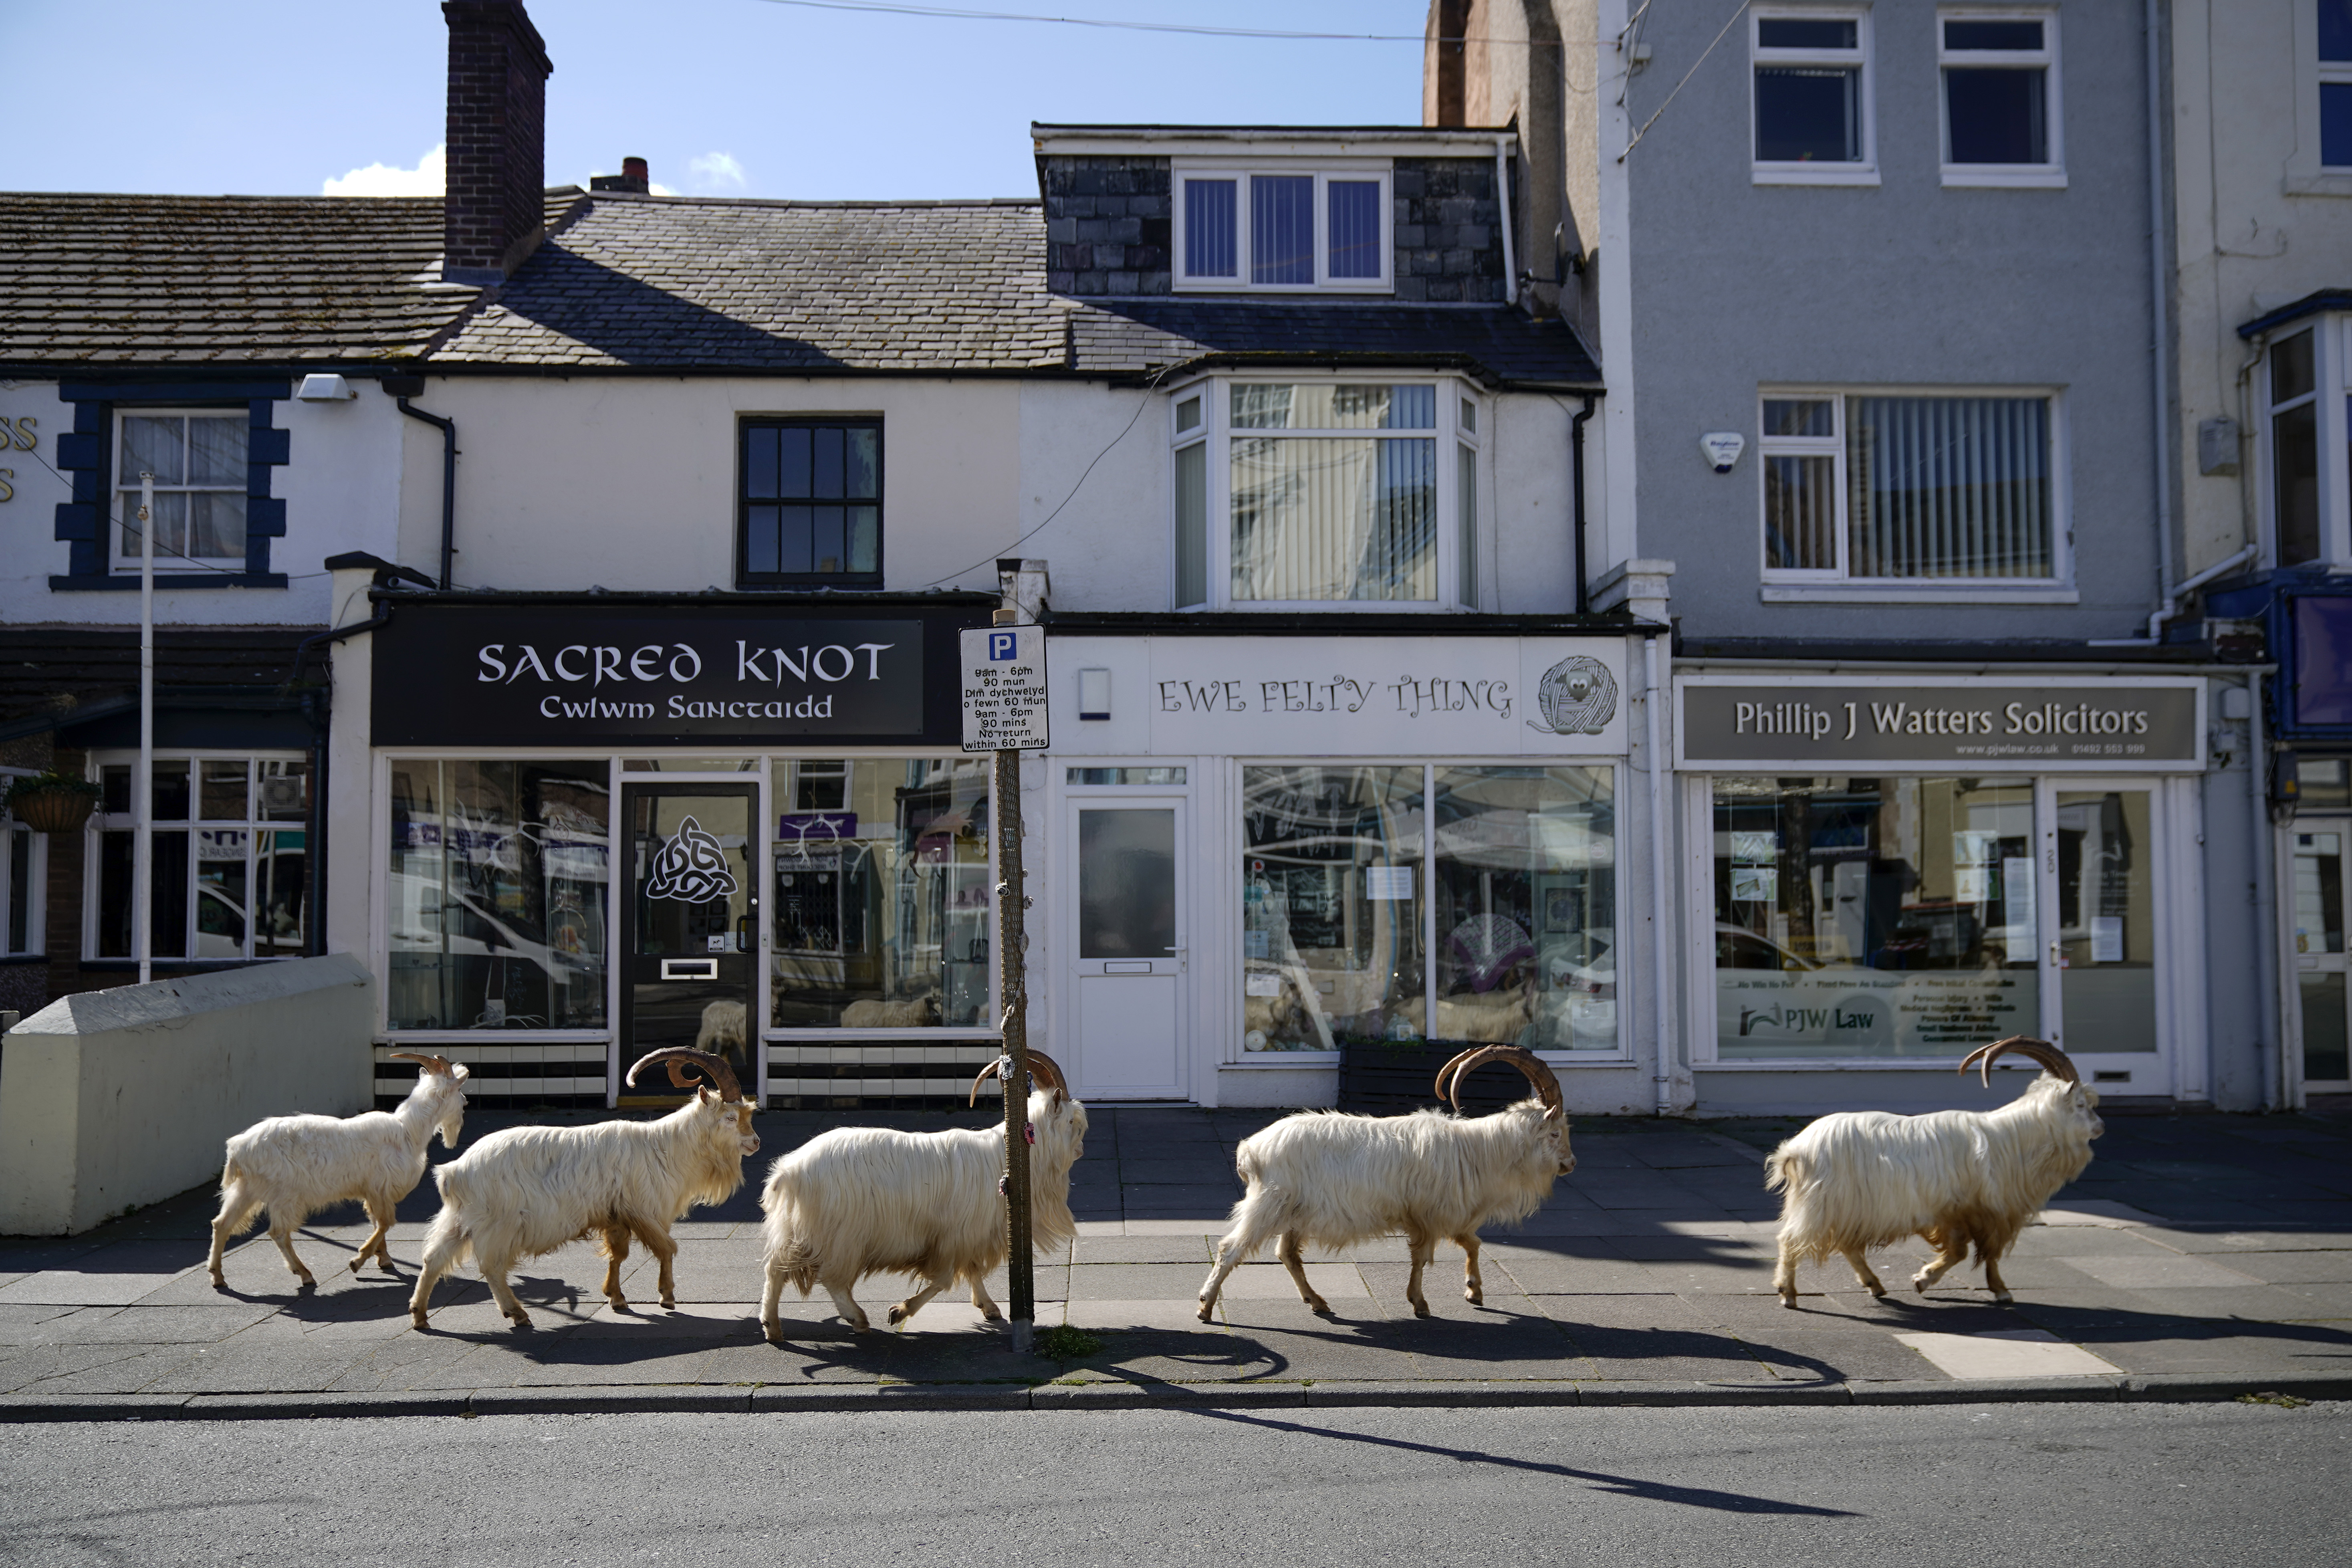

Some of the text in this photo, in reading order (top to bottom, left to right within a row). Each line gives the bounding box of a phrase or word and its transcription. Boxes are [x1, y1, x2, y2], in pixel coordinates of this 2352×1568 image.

[994, 636, 1012, 659] P
[478, 640, 895, 689] SACRED KNOT
[975, 668, 997, 677] 9am
[1011, 667, 1033, 676] 6pm
[984, 678, 998, 686] 90
[965, 686, 1044, 697] Dim dychwelyd
[1158, 674, 1512, 719] EWE FELTY THING
[541, 694, 833, 720] Cwlwm Sanctaidd
[1011, 708, 1033, 717] 6pm
[983, 718, 1026, 728] 90 mins
[1735, 702, 2148, 741] Phillip J Watters Solicitors
[965, 738, 1045, 749] within 60 mins
[1956, 743, 2059, 757] www.pjwlaw.co.uk
[2072, 744, 2102, 754] 01492
[2126, 744, 2145, 754] 999
[1786, 1009, 1874, 1033] PJW Law
